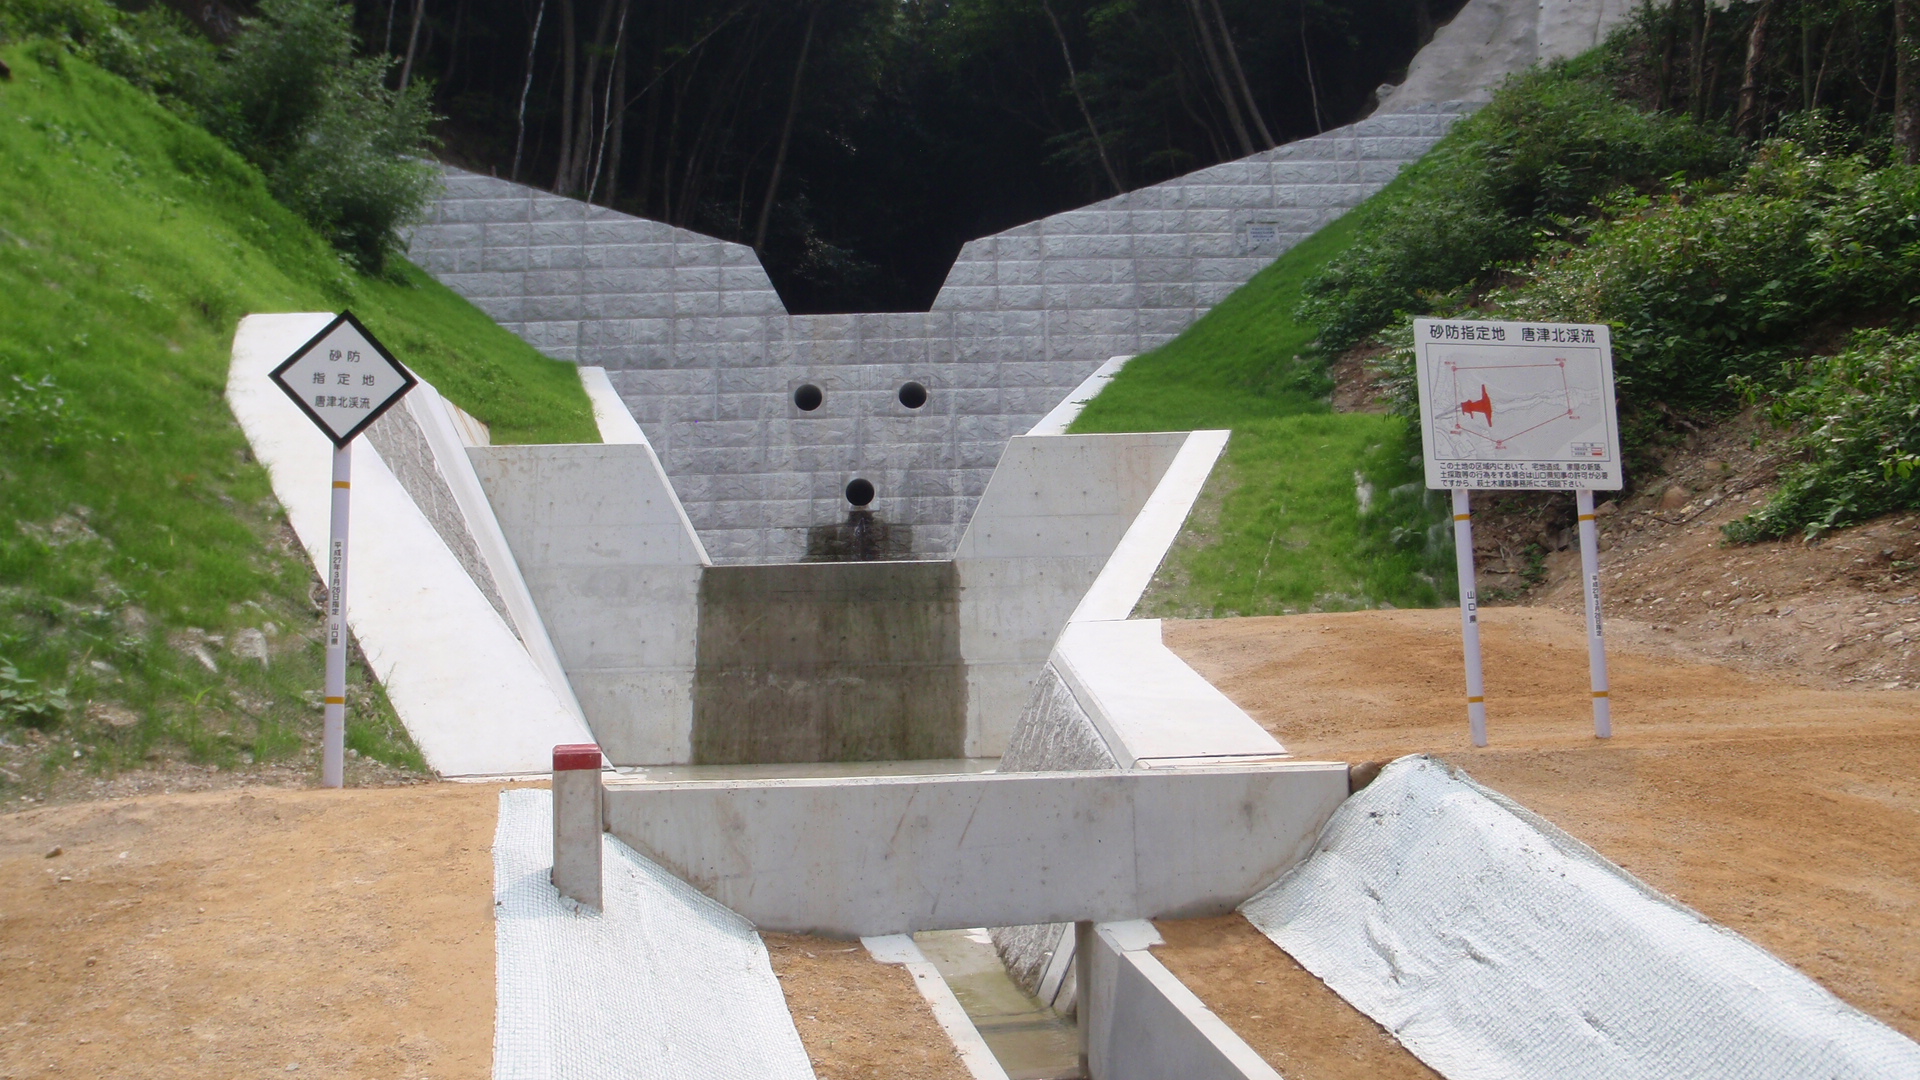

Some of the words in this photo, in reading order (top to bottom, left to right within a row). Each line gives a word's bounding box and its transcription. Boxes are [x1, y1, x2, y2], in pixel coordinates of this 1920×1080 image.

[1429, 324, 1506, 341] 砂防指定地
[1521, 327, 1596, 343] 唐津北渓流
[329, 349, 361, 363] 砂防
[312, 372, 375, 387] 指定地
[314, 395, 371, 409] 唐津北渓流
